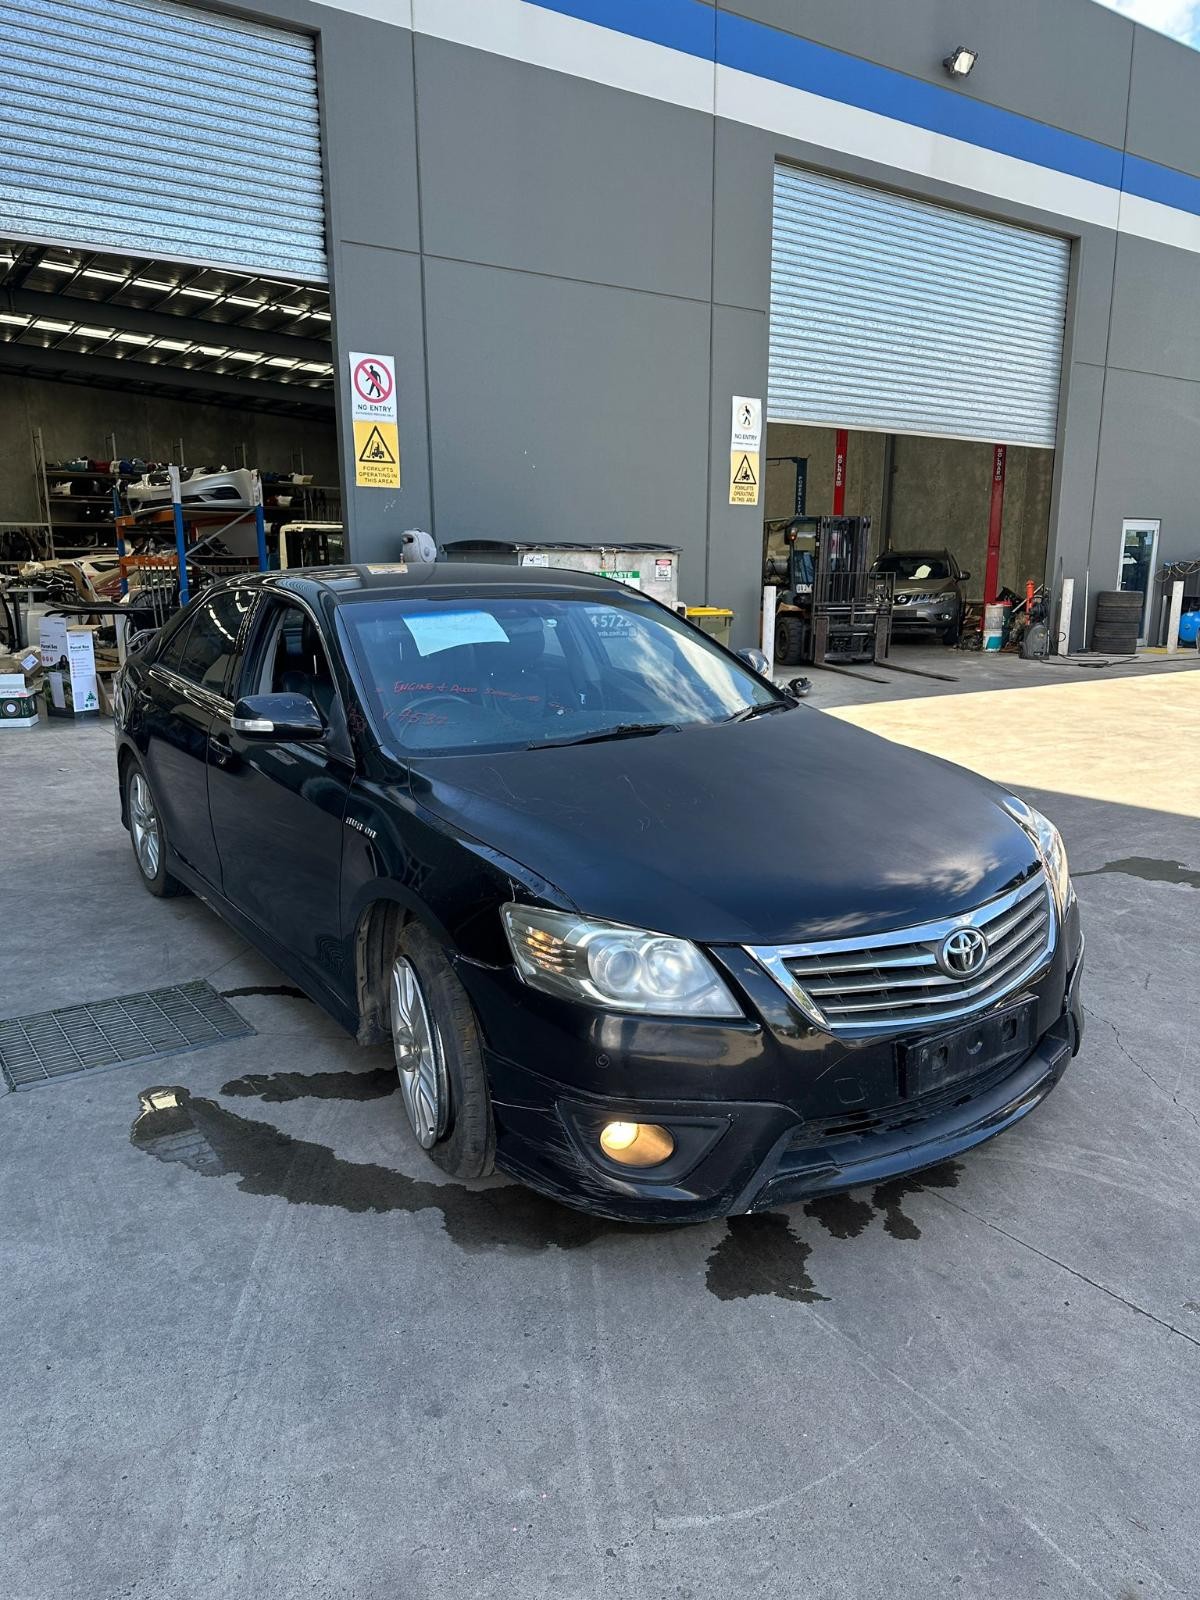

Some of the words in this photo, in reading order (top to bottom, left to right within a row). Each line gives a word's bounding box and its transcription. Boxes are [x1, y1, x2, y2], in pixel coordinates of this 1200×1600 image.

[358, 471, 391, 479] OPERATING
[606, 571, 633, 579] WASTE
[394, 681, 433, 692] ENGINE
